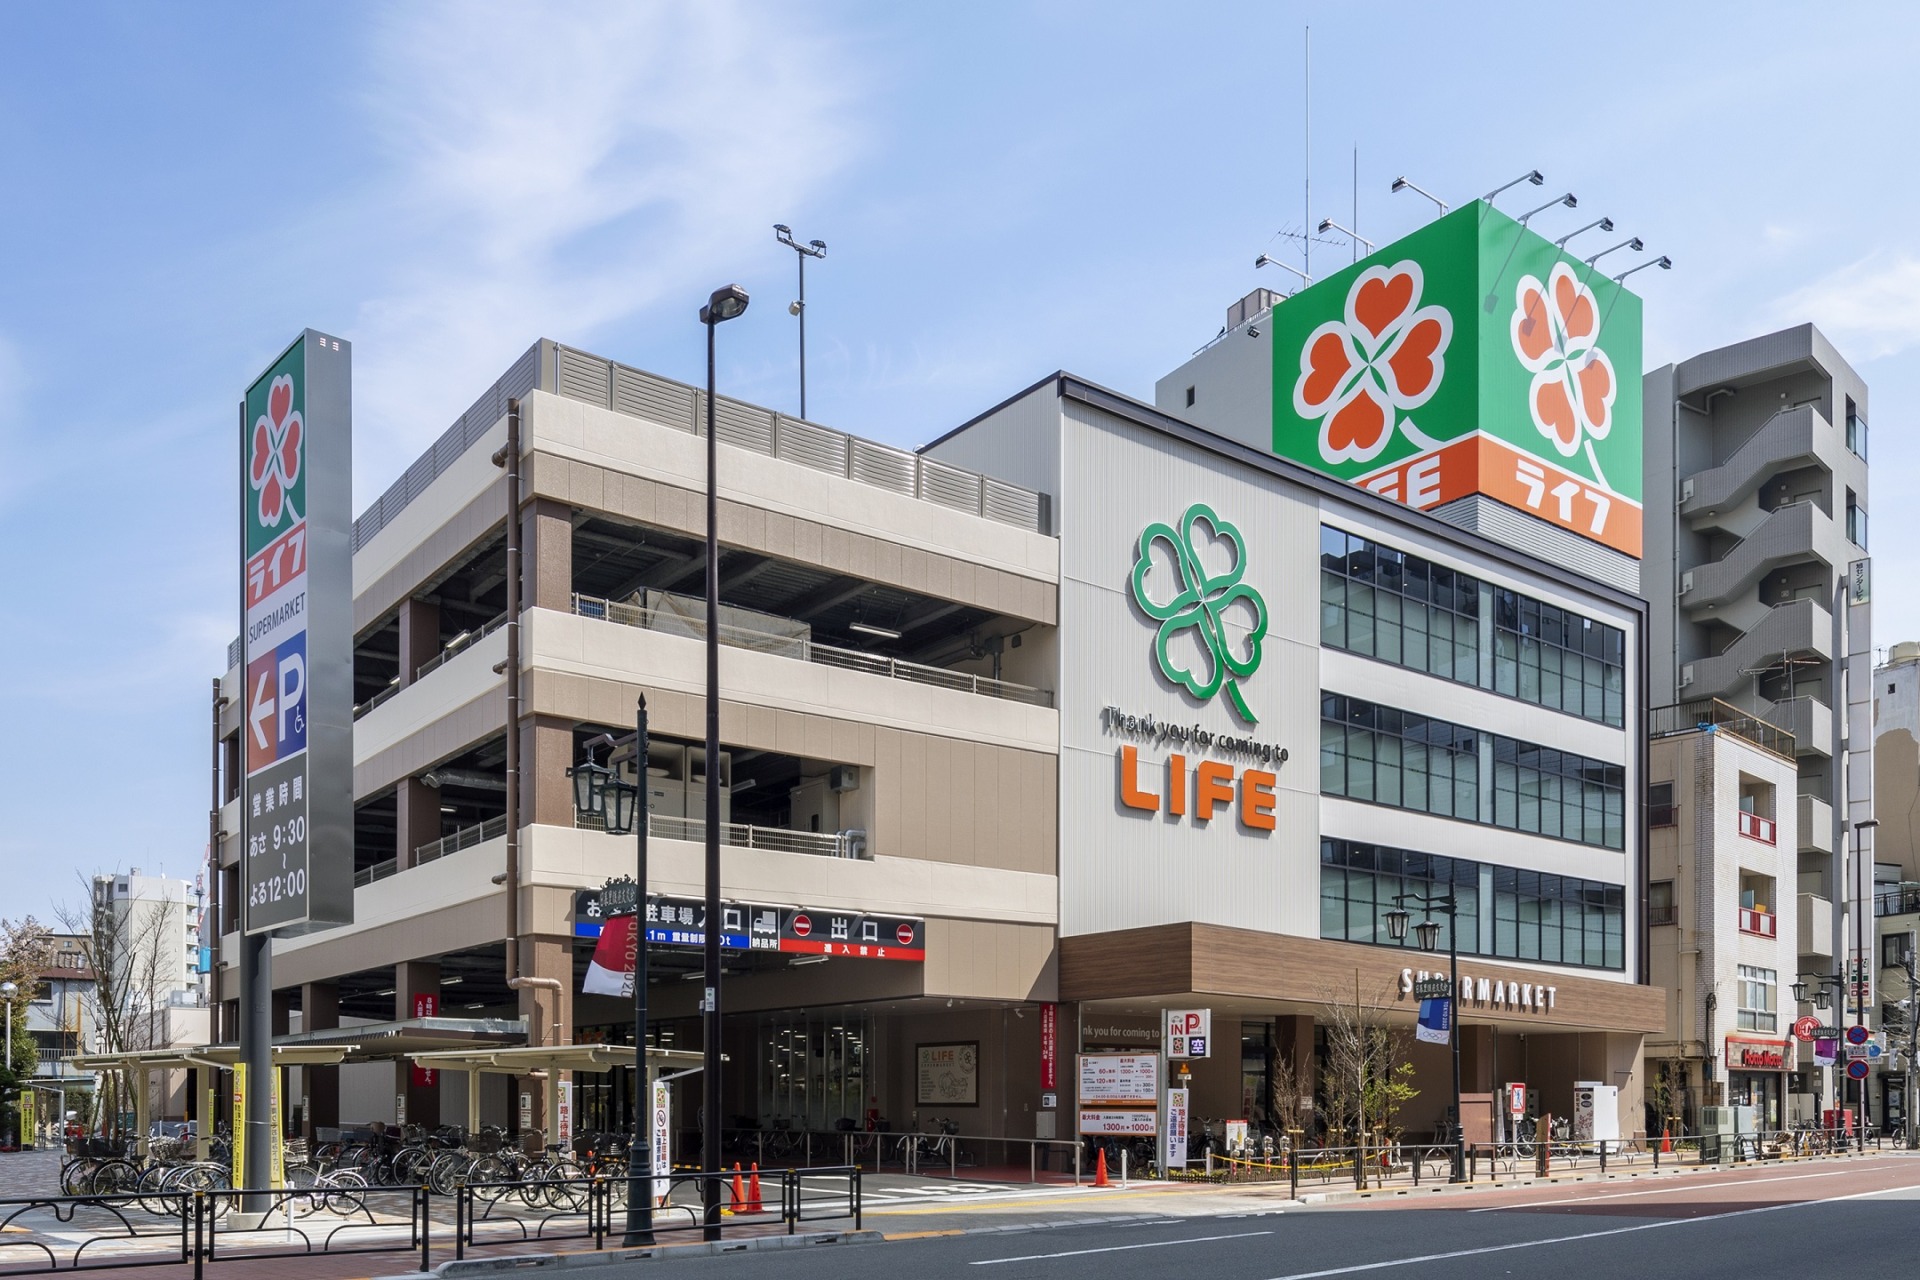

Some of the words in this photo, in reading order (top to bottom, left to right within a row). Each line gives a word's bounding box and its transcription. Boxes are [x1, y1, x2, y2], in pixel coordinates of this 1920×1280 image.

[1516, 459, 1610, 535] ライフ
[249, 528, 305, 600] ライフ
[249, 591, 306, 644] SUPERMARKET
[279, 652, 305, 742] P
[1104, 705, 1157, 735] Thank
[1161, 721, 1189, 741] you
[1193, 723, 1215, 747] for
[1218, 735, 1271, 763] coming
[1275, 743, 1289, 762] to
[252, 775, 303, 818] 営業時間
[1121, 744, 1276, 831] LIFE
[249, 831, 267, 858] あさ
[273, 815, 305, 850] 9:30
[752, 937, 778, 949] 納品所
[824, 943, 885, 957] 進入禁止
[830, 917, 879, 942] 出口
[1083, 1025, 1093, 1036] nk
[1094, 1027, 1109, 1039] you
[1110, 1026, 1121, 1036] for
[1122, 1027, 1151, 1040] coming
[1152, 1029, 1160, 1038] to
[1171, 1023, 1183, 1035] IN
[1185, 1013, 1200, 1035] P
[931, 1050, 954, 1061] LIFE
[1191, 1038, 1204, 1054] 空
